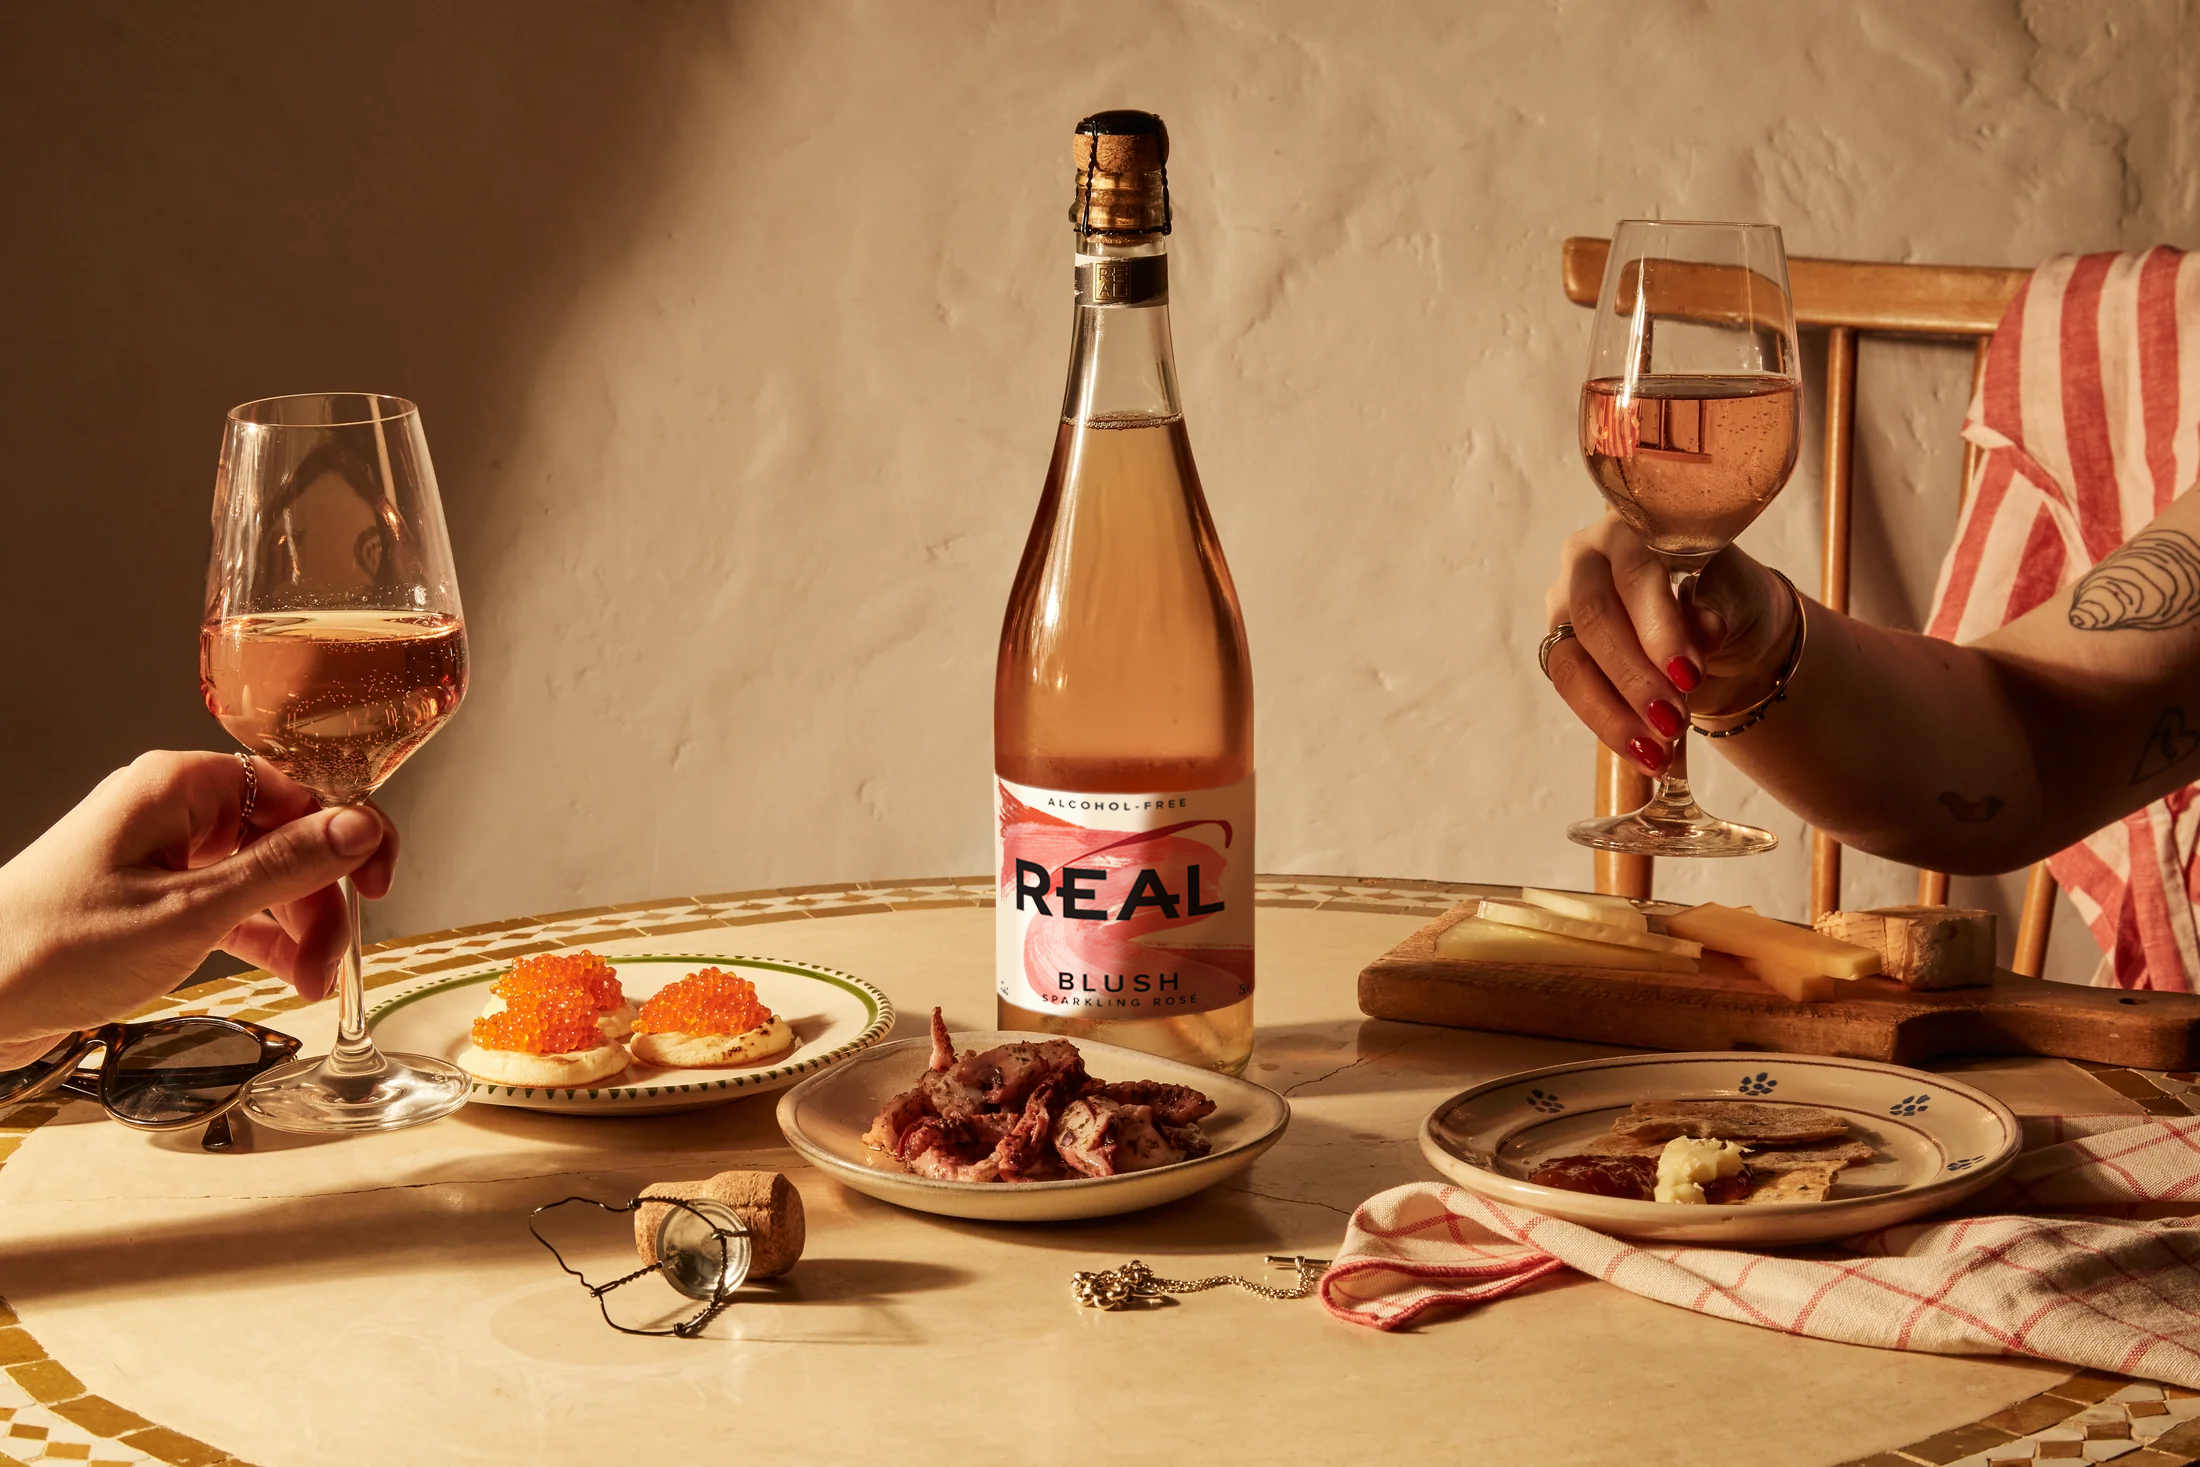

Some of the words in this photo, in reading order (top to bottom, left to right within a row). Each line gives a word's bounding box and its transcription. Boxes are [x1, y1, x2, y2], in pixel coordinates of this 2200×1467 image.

[1048, 798, 1187, 811] ALCOHOL-FREE
[1016, 857, 1225, 921] REAL
[1058, 972, 1179, 993] BLUSH
[1042, 993, 1141, 1007] SPARKLING
[1153, 993, 1197, 1006] ROSÉ
